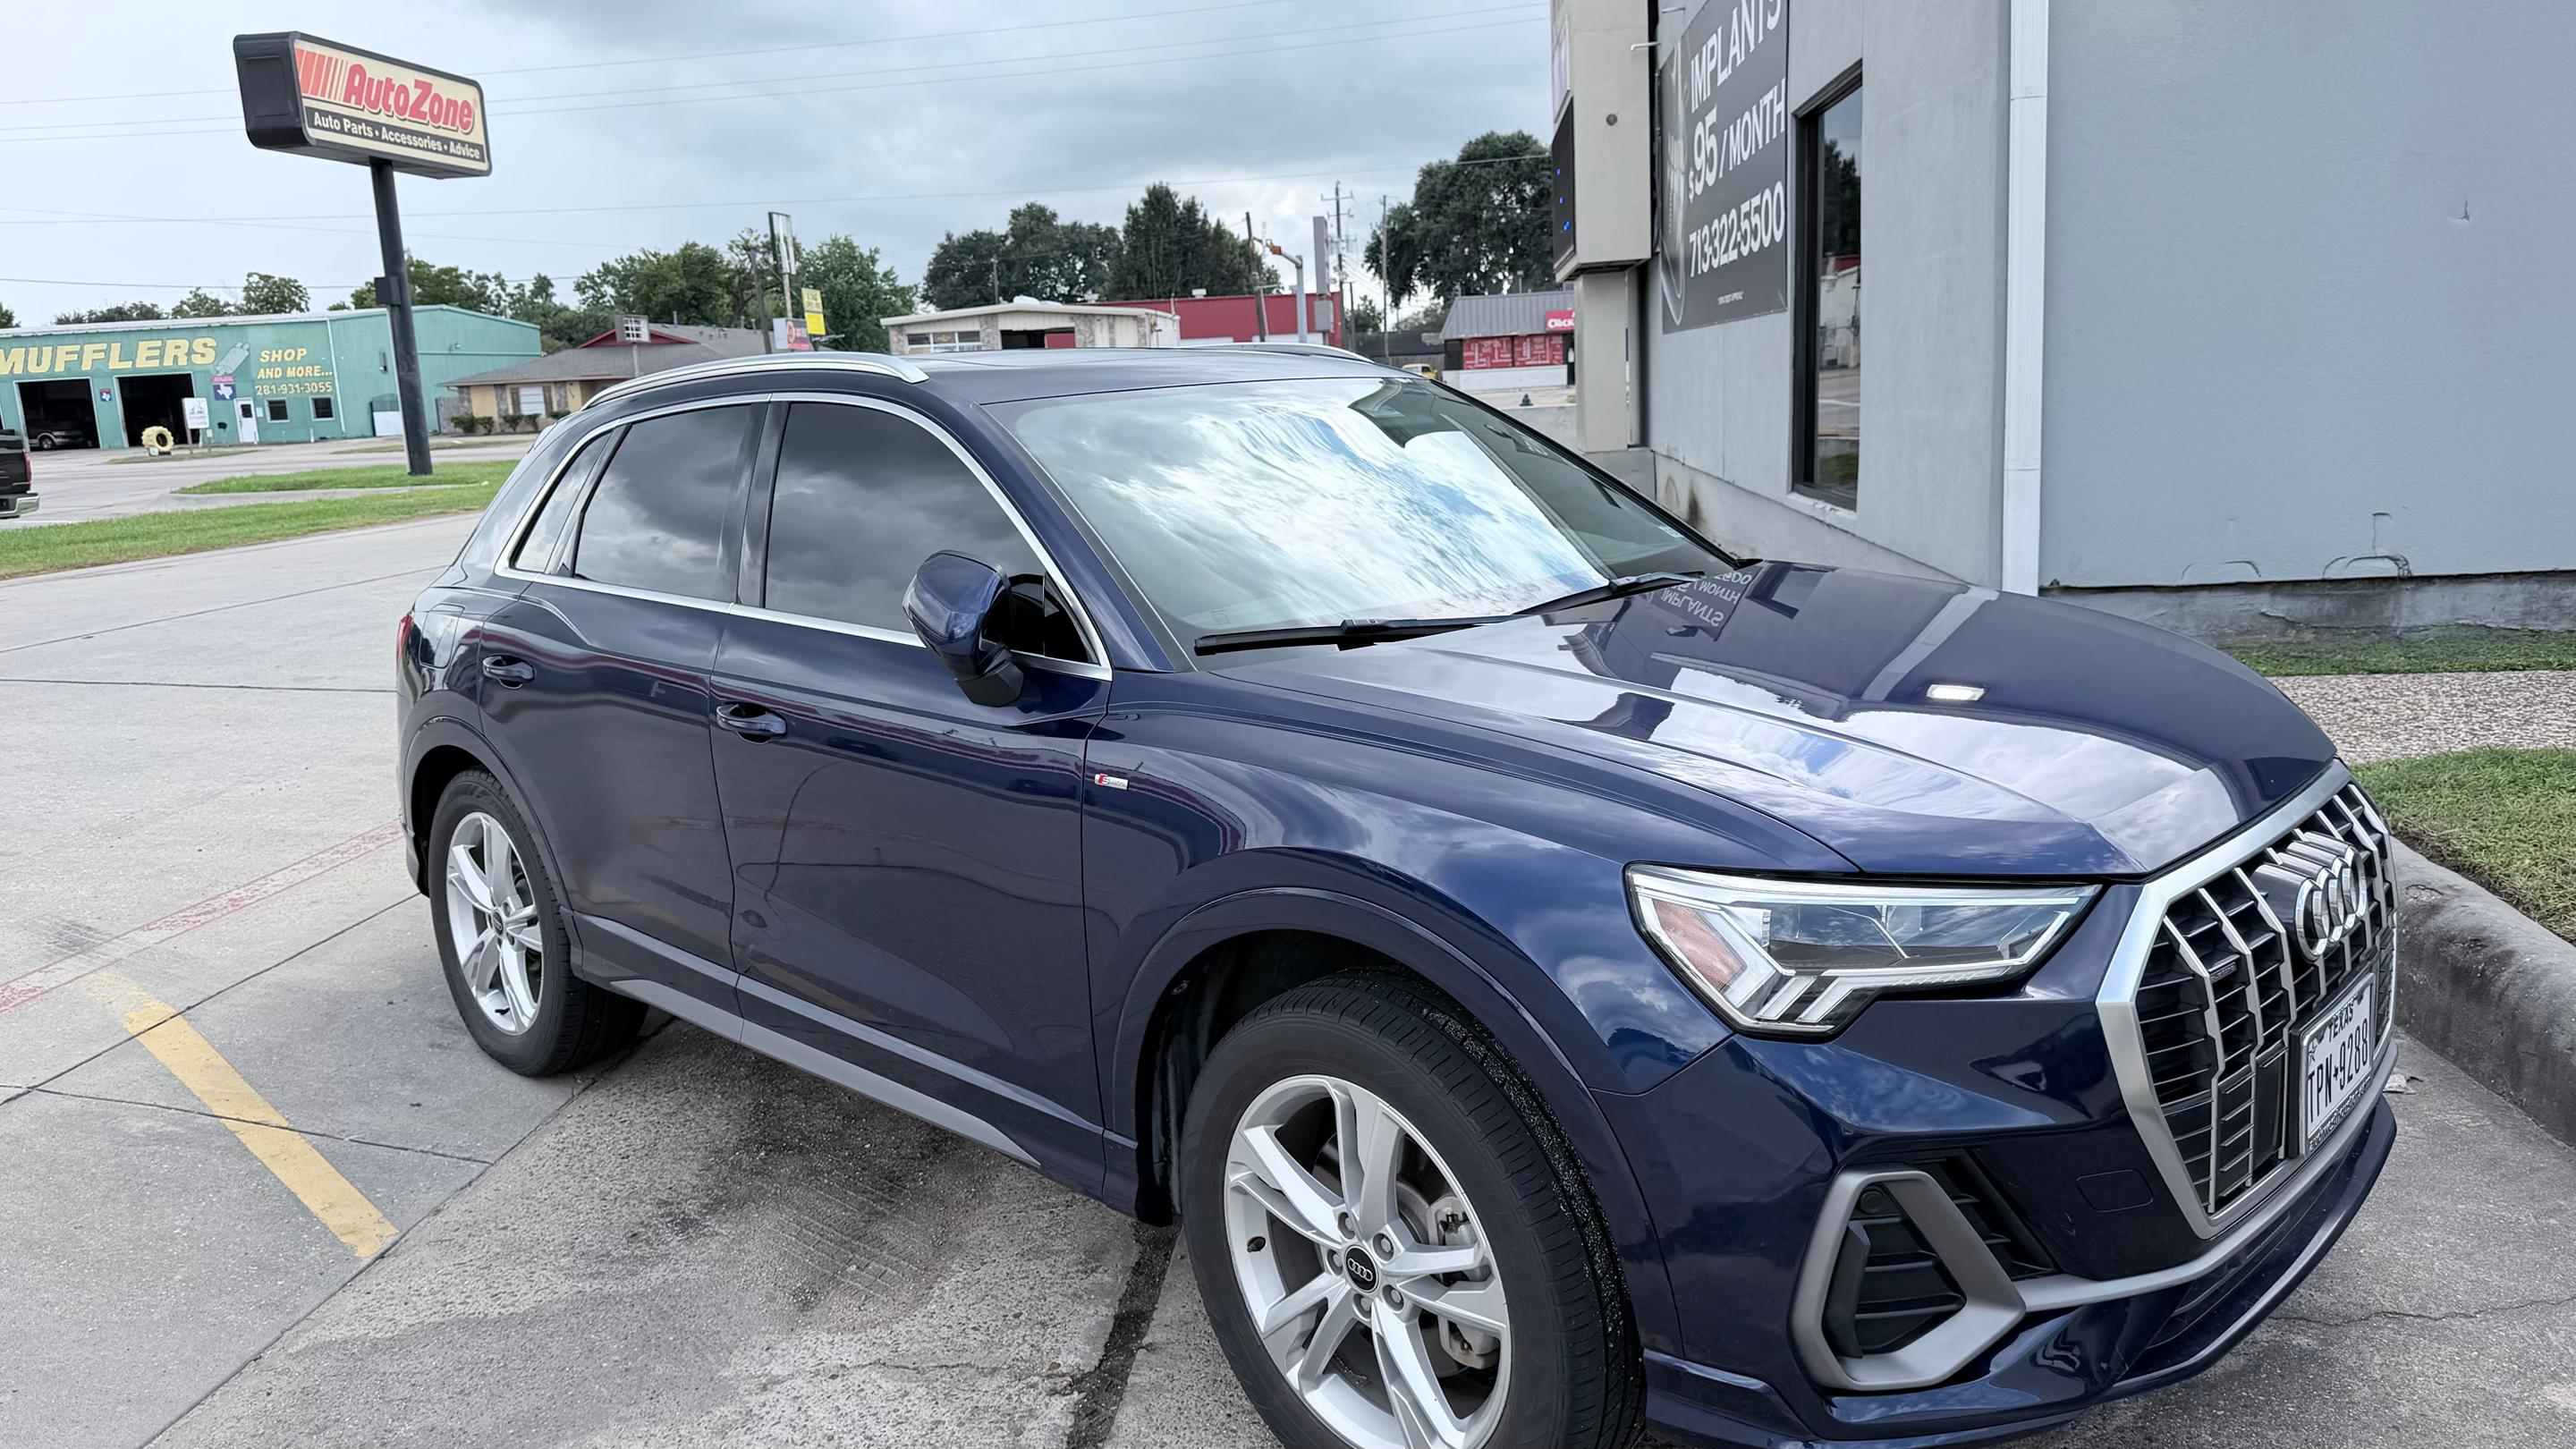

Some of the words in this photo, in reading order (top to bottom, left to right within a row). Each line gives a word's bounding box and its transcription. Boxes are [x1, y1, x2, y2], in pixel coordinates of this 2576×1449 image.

[343, 63, 474, 135] AutoZone
[314, 111, 341, 131] Auto
[343, 118, 374, 138] Parts
[381, 126, 443, 152] Accessories
[449, 143, 480, 160] Advice
[0, 336, 217, 375] MUFFLERS
[257, 367, 283, 379] AND
[259, 348, 308, 363] SHOP
[255, 381, 333, 396] 281-931-3055
[2327, 1004, 2354, 1043] TEXAS
